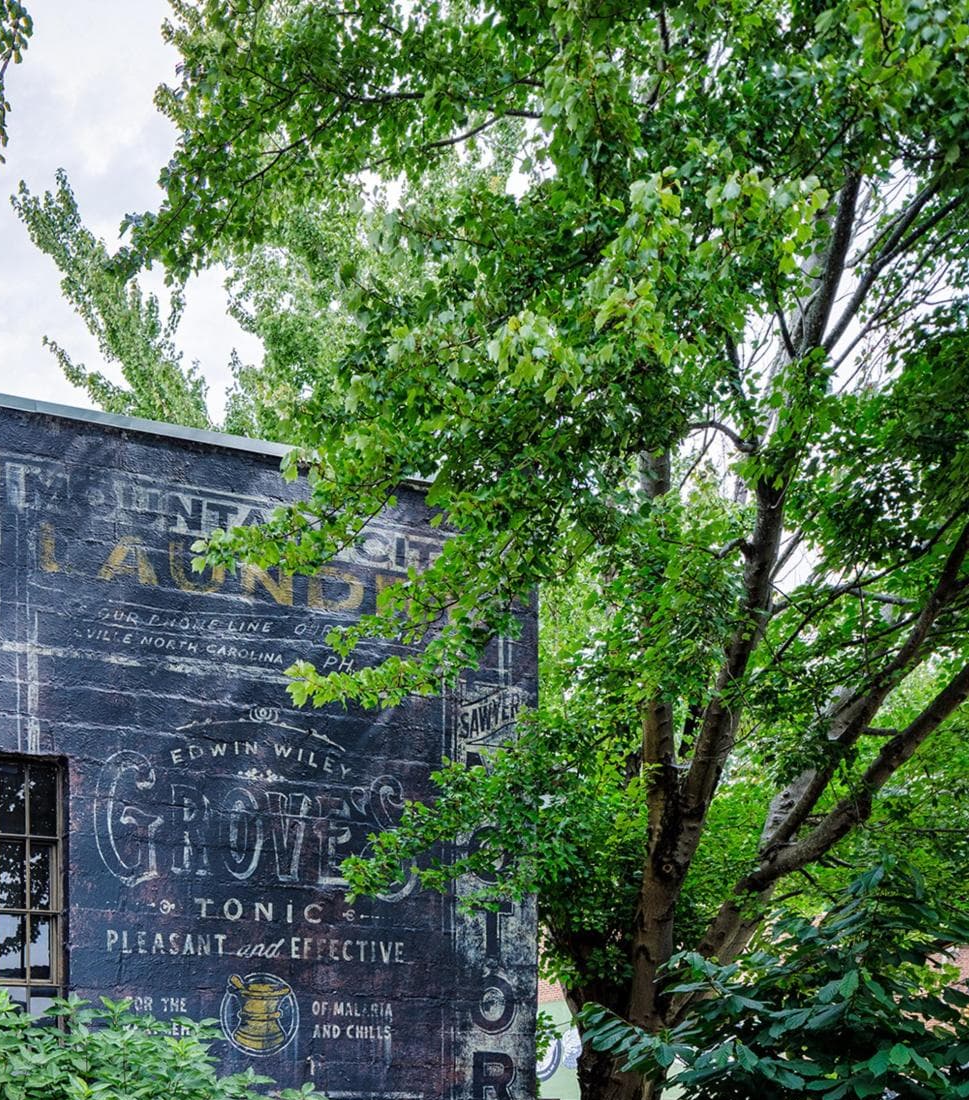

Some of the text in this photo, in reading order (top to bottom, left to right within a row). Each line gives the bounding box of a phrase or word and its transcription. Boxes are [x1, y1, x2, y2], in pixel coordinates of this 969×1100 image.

[353, 527, 460, 573] CIT
[39, 519, 468, 624] LAUND
[228, 620, 274, 633] LINE
[140, 636, 198, 653] NORTH
[206, 643, 283, 664] CAROLINA
[170, 741, 352, 780] EDWIN WILEY
[194, 897, 324, 924] TONIC
[106, 929, 407, 963] PLEASANT and EFFECTIVE
[161, 997, 188, 1012] THE
[312, 1000, 329, 1016] OF
[313, 1024, 393, 1040] AND CHILLS
